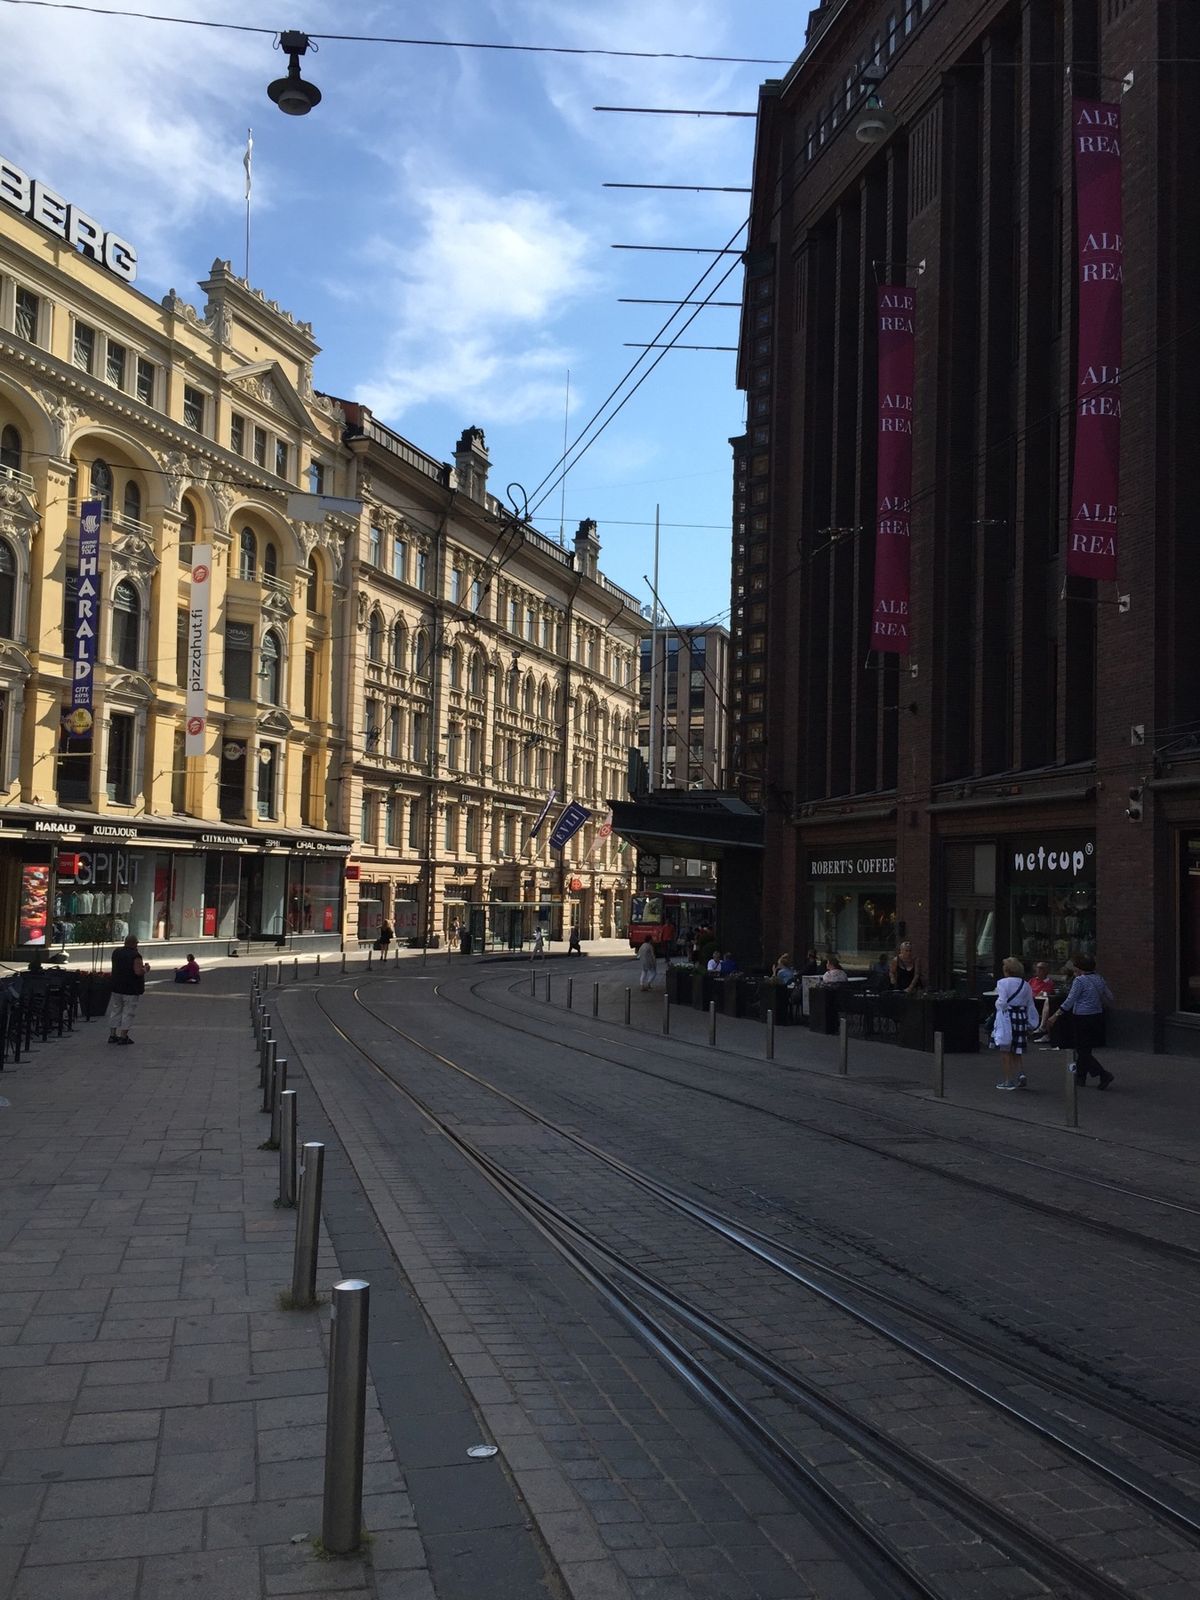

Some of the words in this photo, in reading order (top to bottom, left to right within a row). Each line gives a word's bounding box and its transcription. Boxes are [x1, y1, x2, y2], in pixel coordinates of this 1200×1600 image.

[1077, 108, 1119, 129] ALE
[1079, 136, 1120, 156] REA
[0, 156, 137, 282] BERG
[881, 295, 913, 311] ALE
[881, 317, 913, 333] REA
[881, 394, 912, 411] ALE
[1074, 503, 1117, 525] ALE
[1072, 533, 1116, 557] REA
[876, 599, 908, 615] ALE
[75, 556, 97, 680] HARALD
[874, 621, 907, 637] REA
[189, 609, 203, 692] pizzahut.fi
[35, 821, 77, 833] HARALD
[93, 825, 138, 837] KULTAJOUSI
[556, 812, 580, 841] EVLI
[202, 834, 249, 845] CITYKLINIKKA
[811, 859, 853, 875] ROBERT'S
[856, 858, 896, 873] COFFEE
